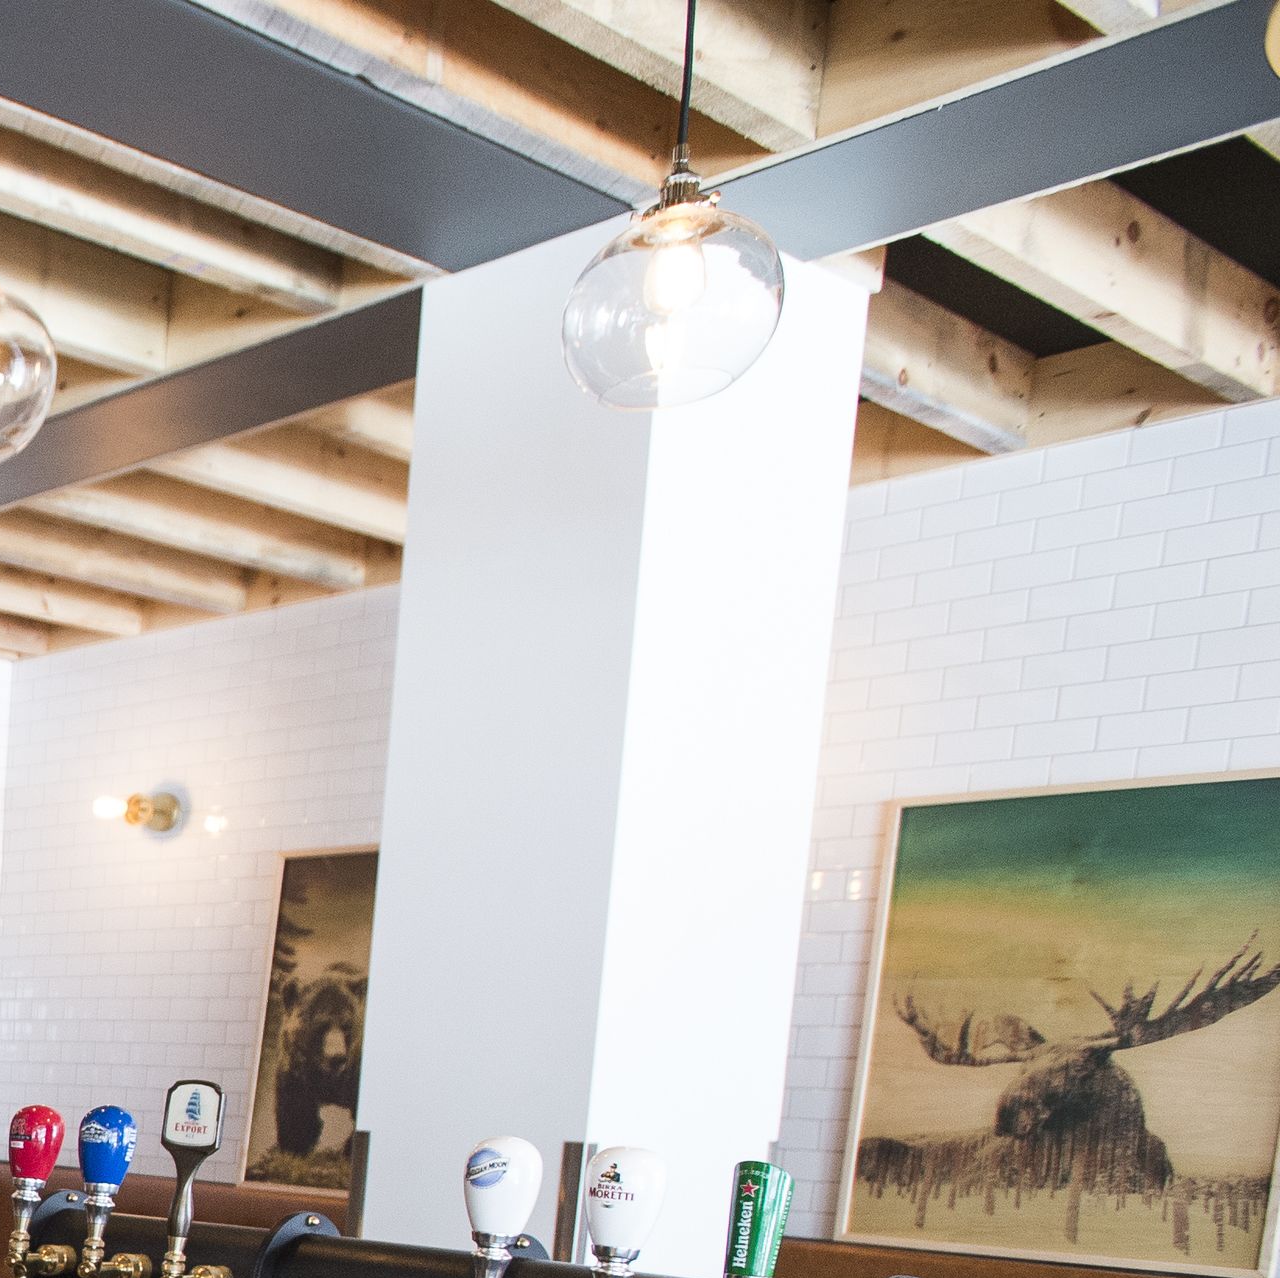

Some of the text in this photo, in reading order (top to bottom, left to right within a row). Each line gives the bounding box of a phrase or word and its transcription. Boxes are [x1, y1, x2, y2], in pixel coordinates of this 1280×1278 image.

[174, 1122, 209, 1135] EXPORT
[589, 1186, 634, 1201] MORETTI
[732, 1200, 754, 1269] Heineken
